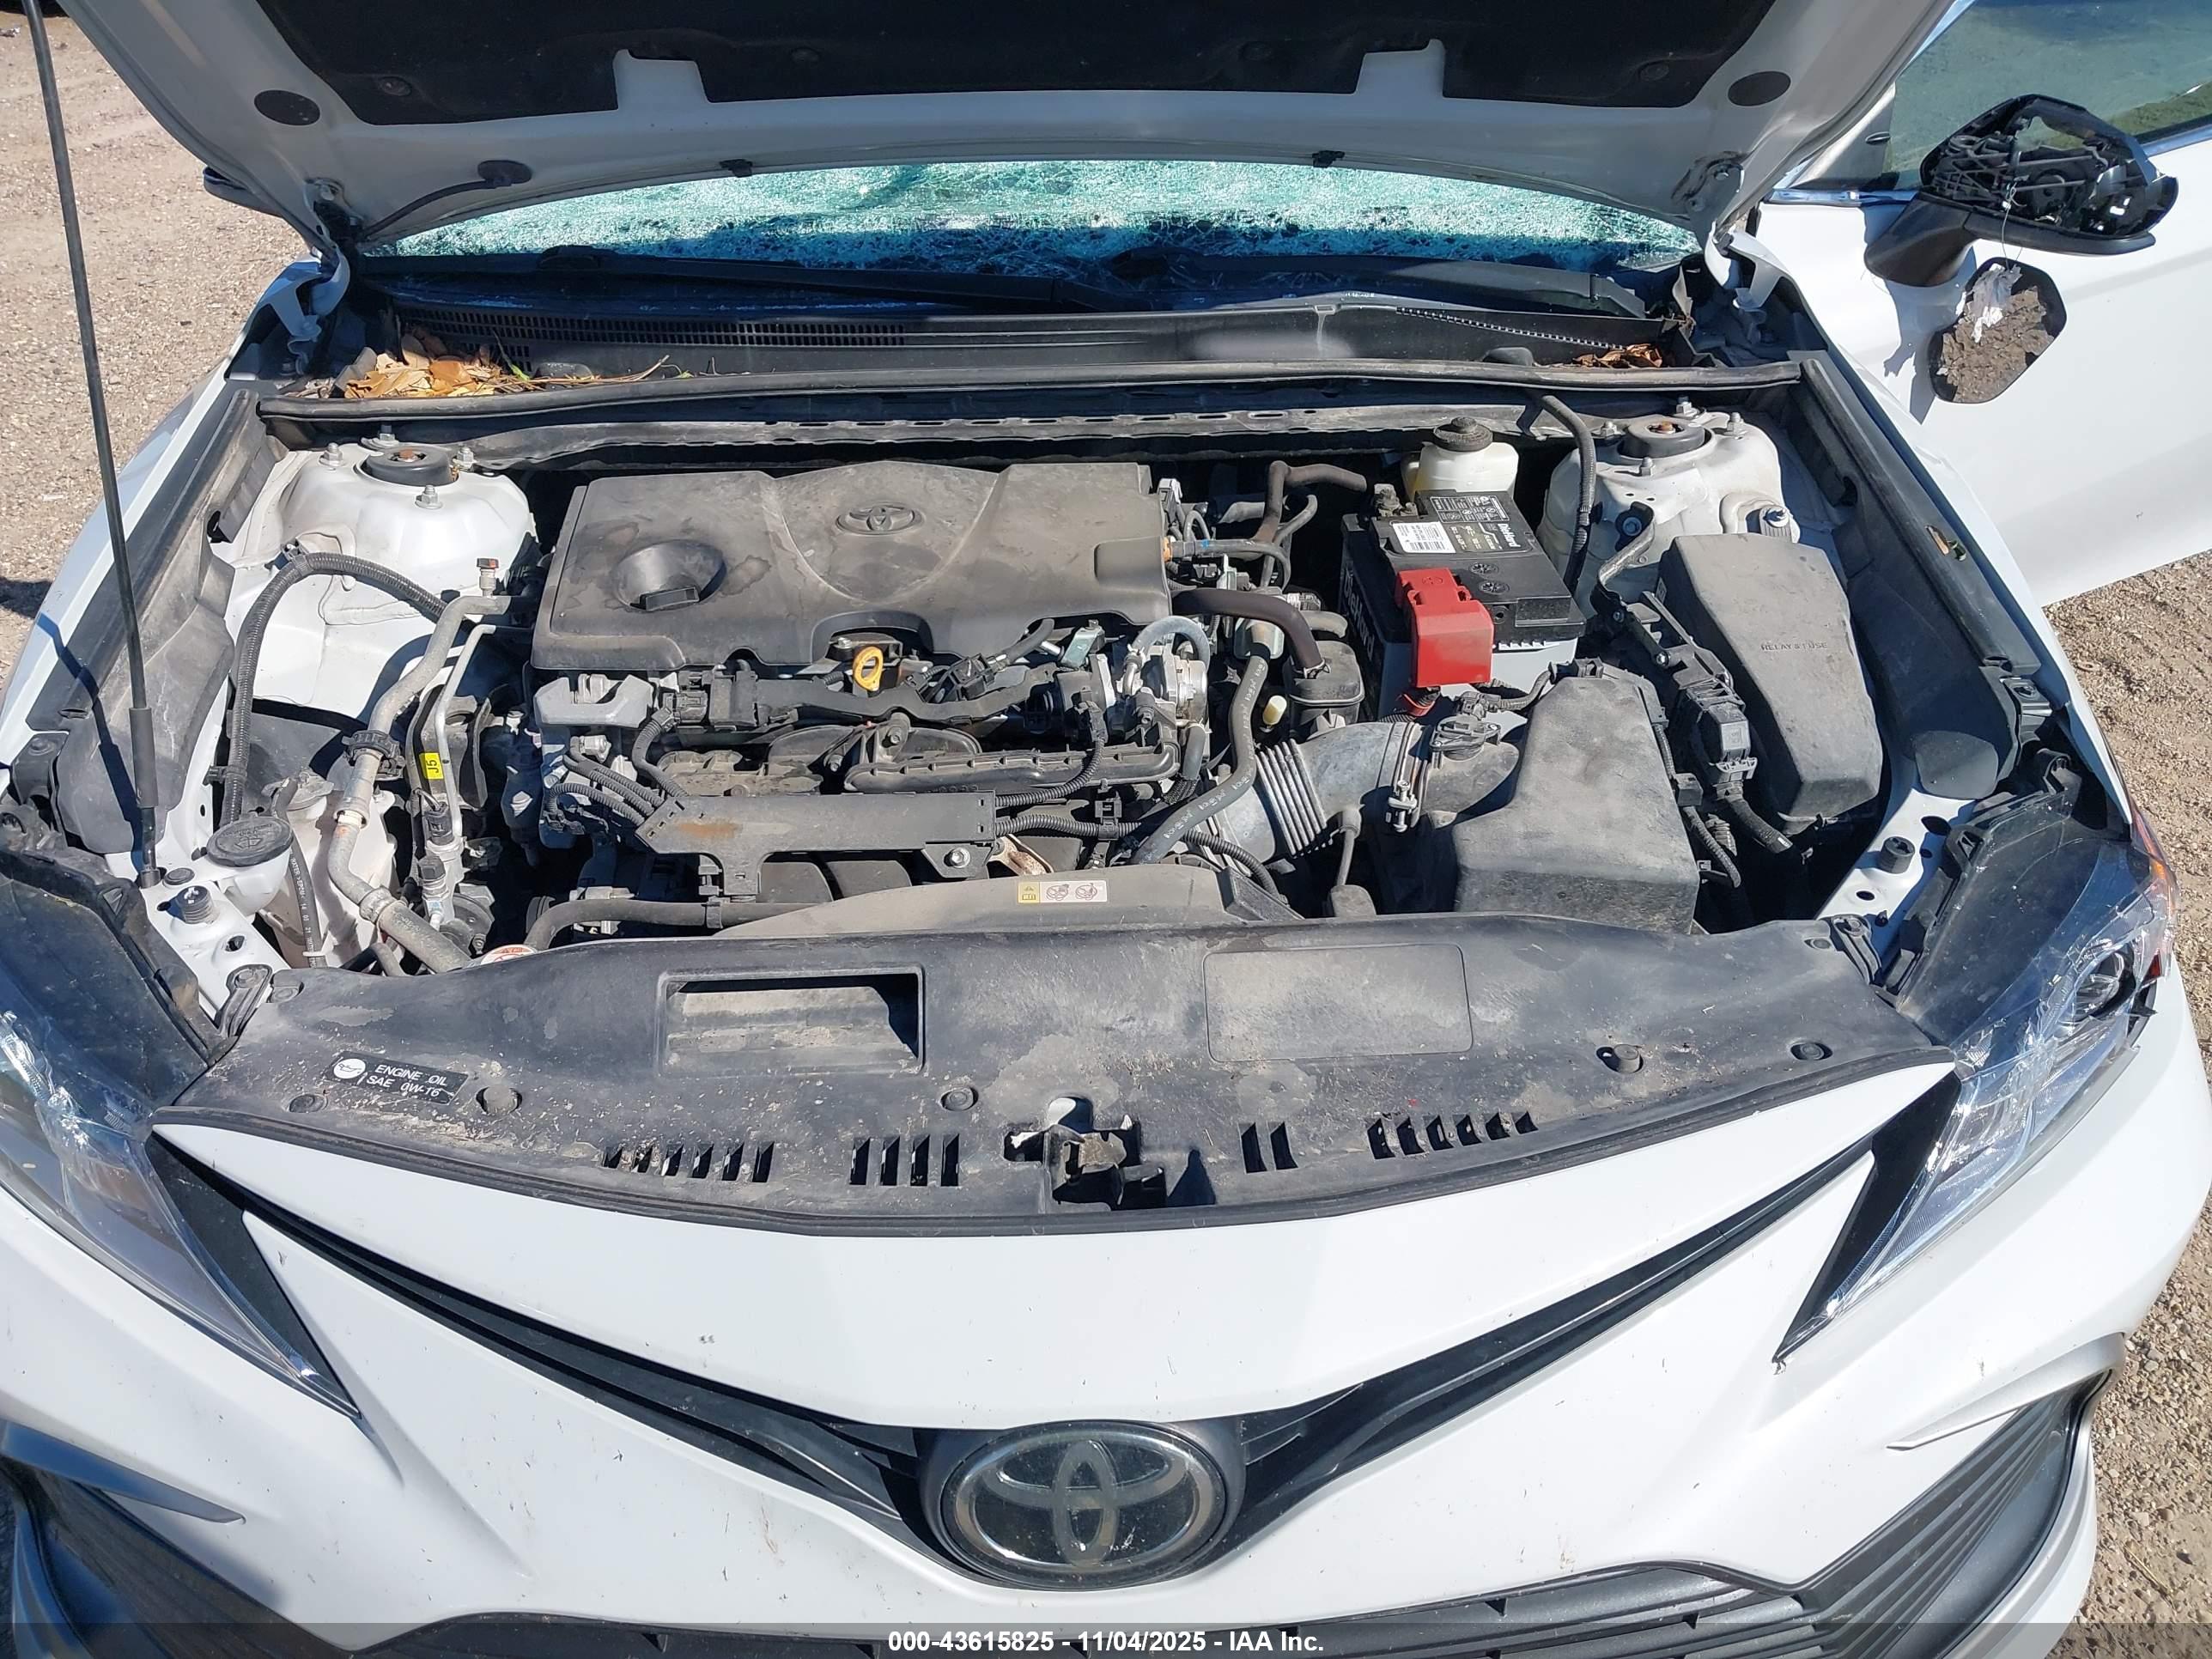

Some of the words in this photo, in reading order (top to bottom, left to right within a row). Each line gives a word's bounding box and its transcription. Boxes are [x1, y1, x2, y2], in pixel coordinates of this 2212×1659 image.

[1497, 523, 1522, 548] DieHard
[1759, 642, 1792, 651] RELAY
[366, 1075, 395, 1088] SAE
[374, 1064, 424, 1081] ENGINE
[428, 1074, 447, 1086] OIL
